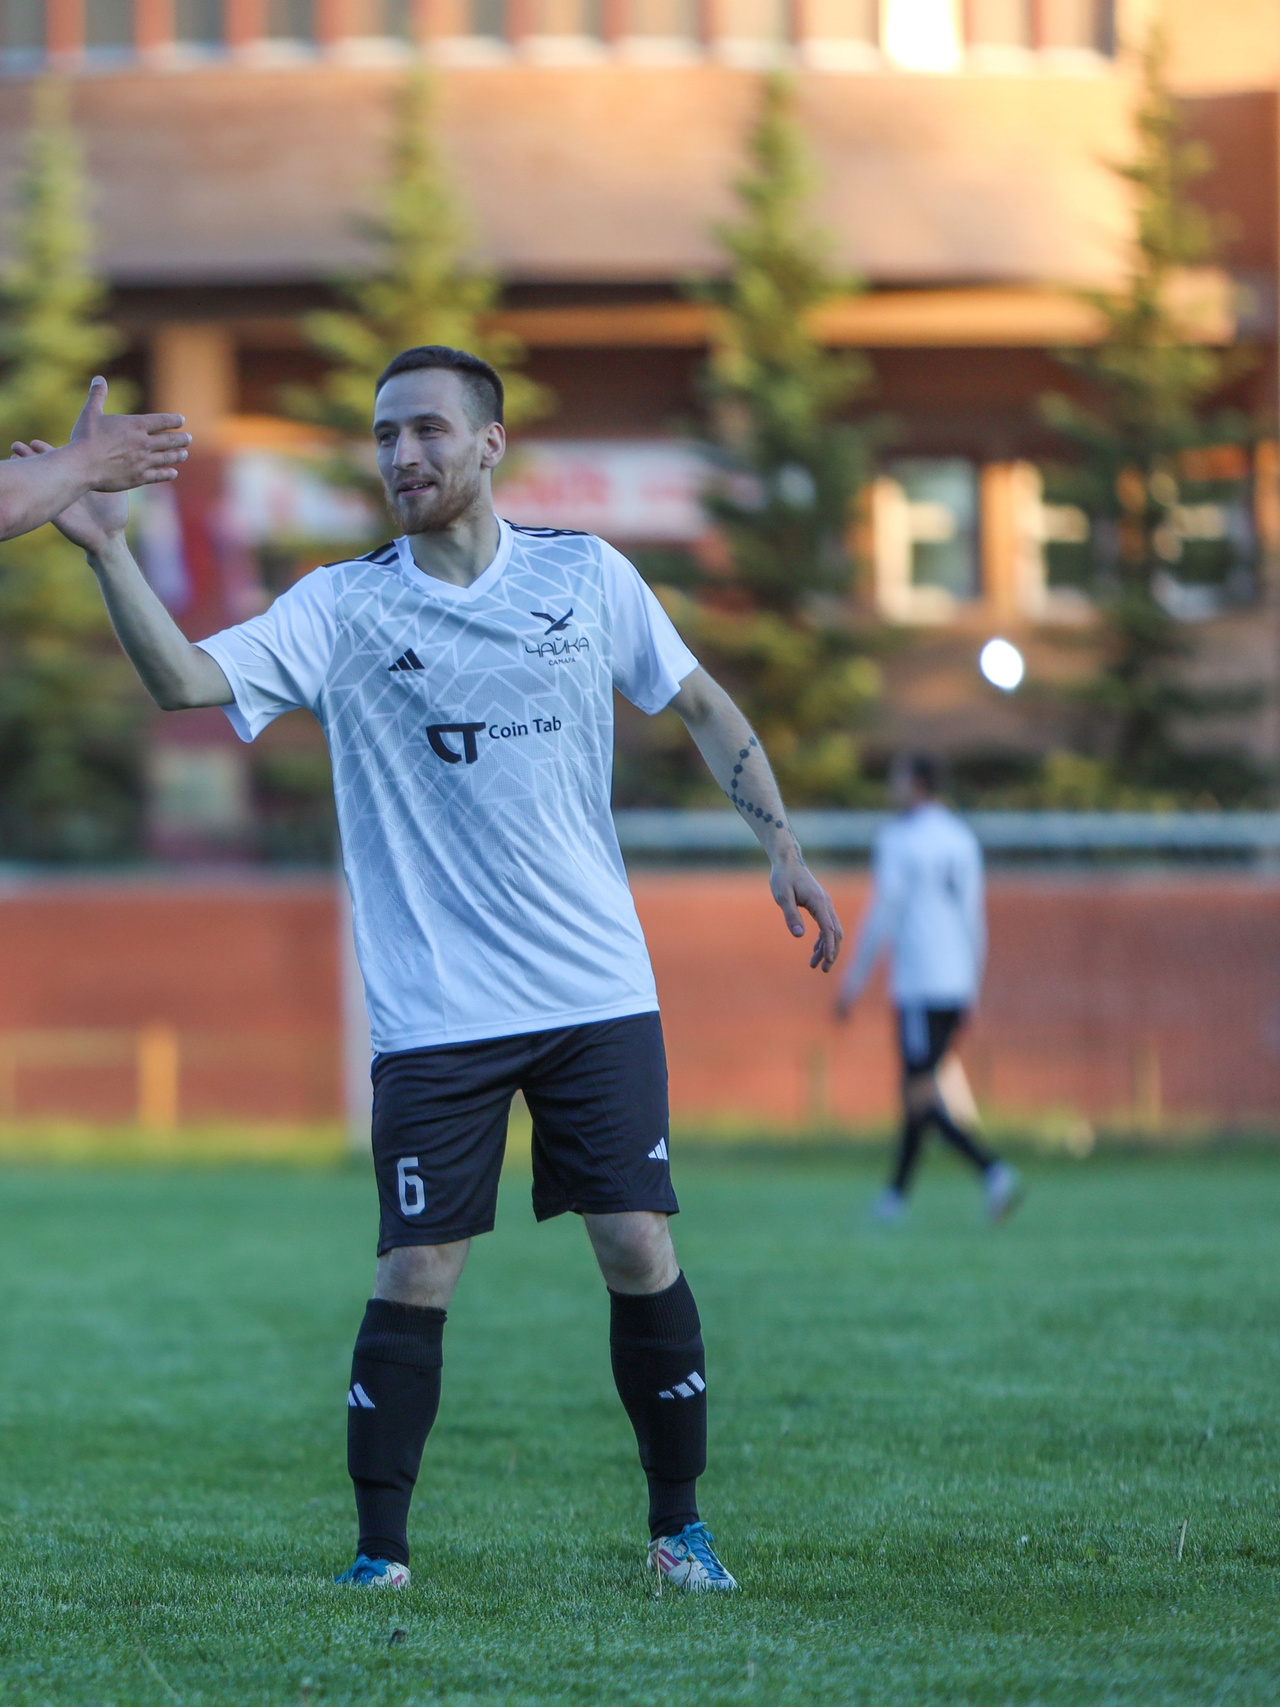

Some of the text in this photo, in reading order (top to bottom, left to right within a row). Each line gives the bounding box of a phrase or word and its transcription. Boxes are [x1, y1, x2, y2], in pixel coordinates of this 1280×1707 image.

[525, 637, 590, 657] ЧАЙКА
[489, 721, 528, 739] Coin
[532, 716, 562, 733] Tab
[397, 1157, 426, 1216] 6
